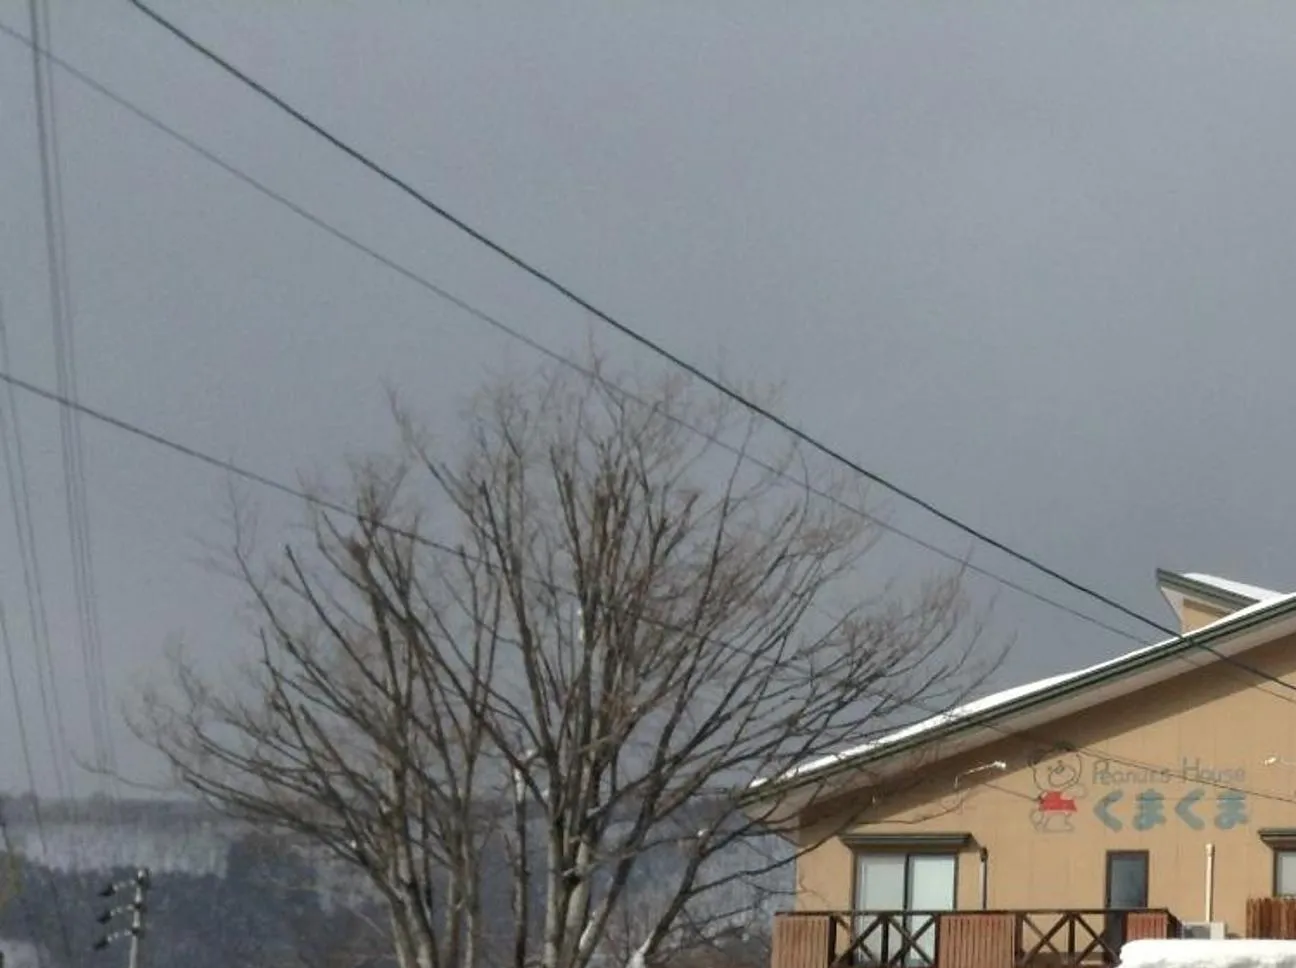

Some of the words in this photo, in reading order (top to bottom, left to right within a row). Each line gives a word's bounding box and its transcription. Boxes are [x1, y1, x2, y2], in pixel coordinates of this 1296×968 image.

[1182, 756, 1246, 783] House
[1093, 788, 1249, 831] くまくま
